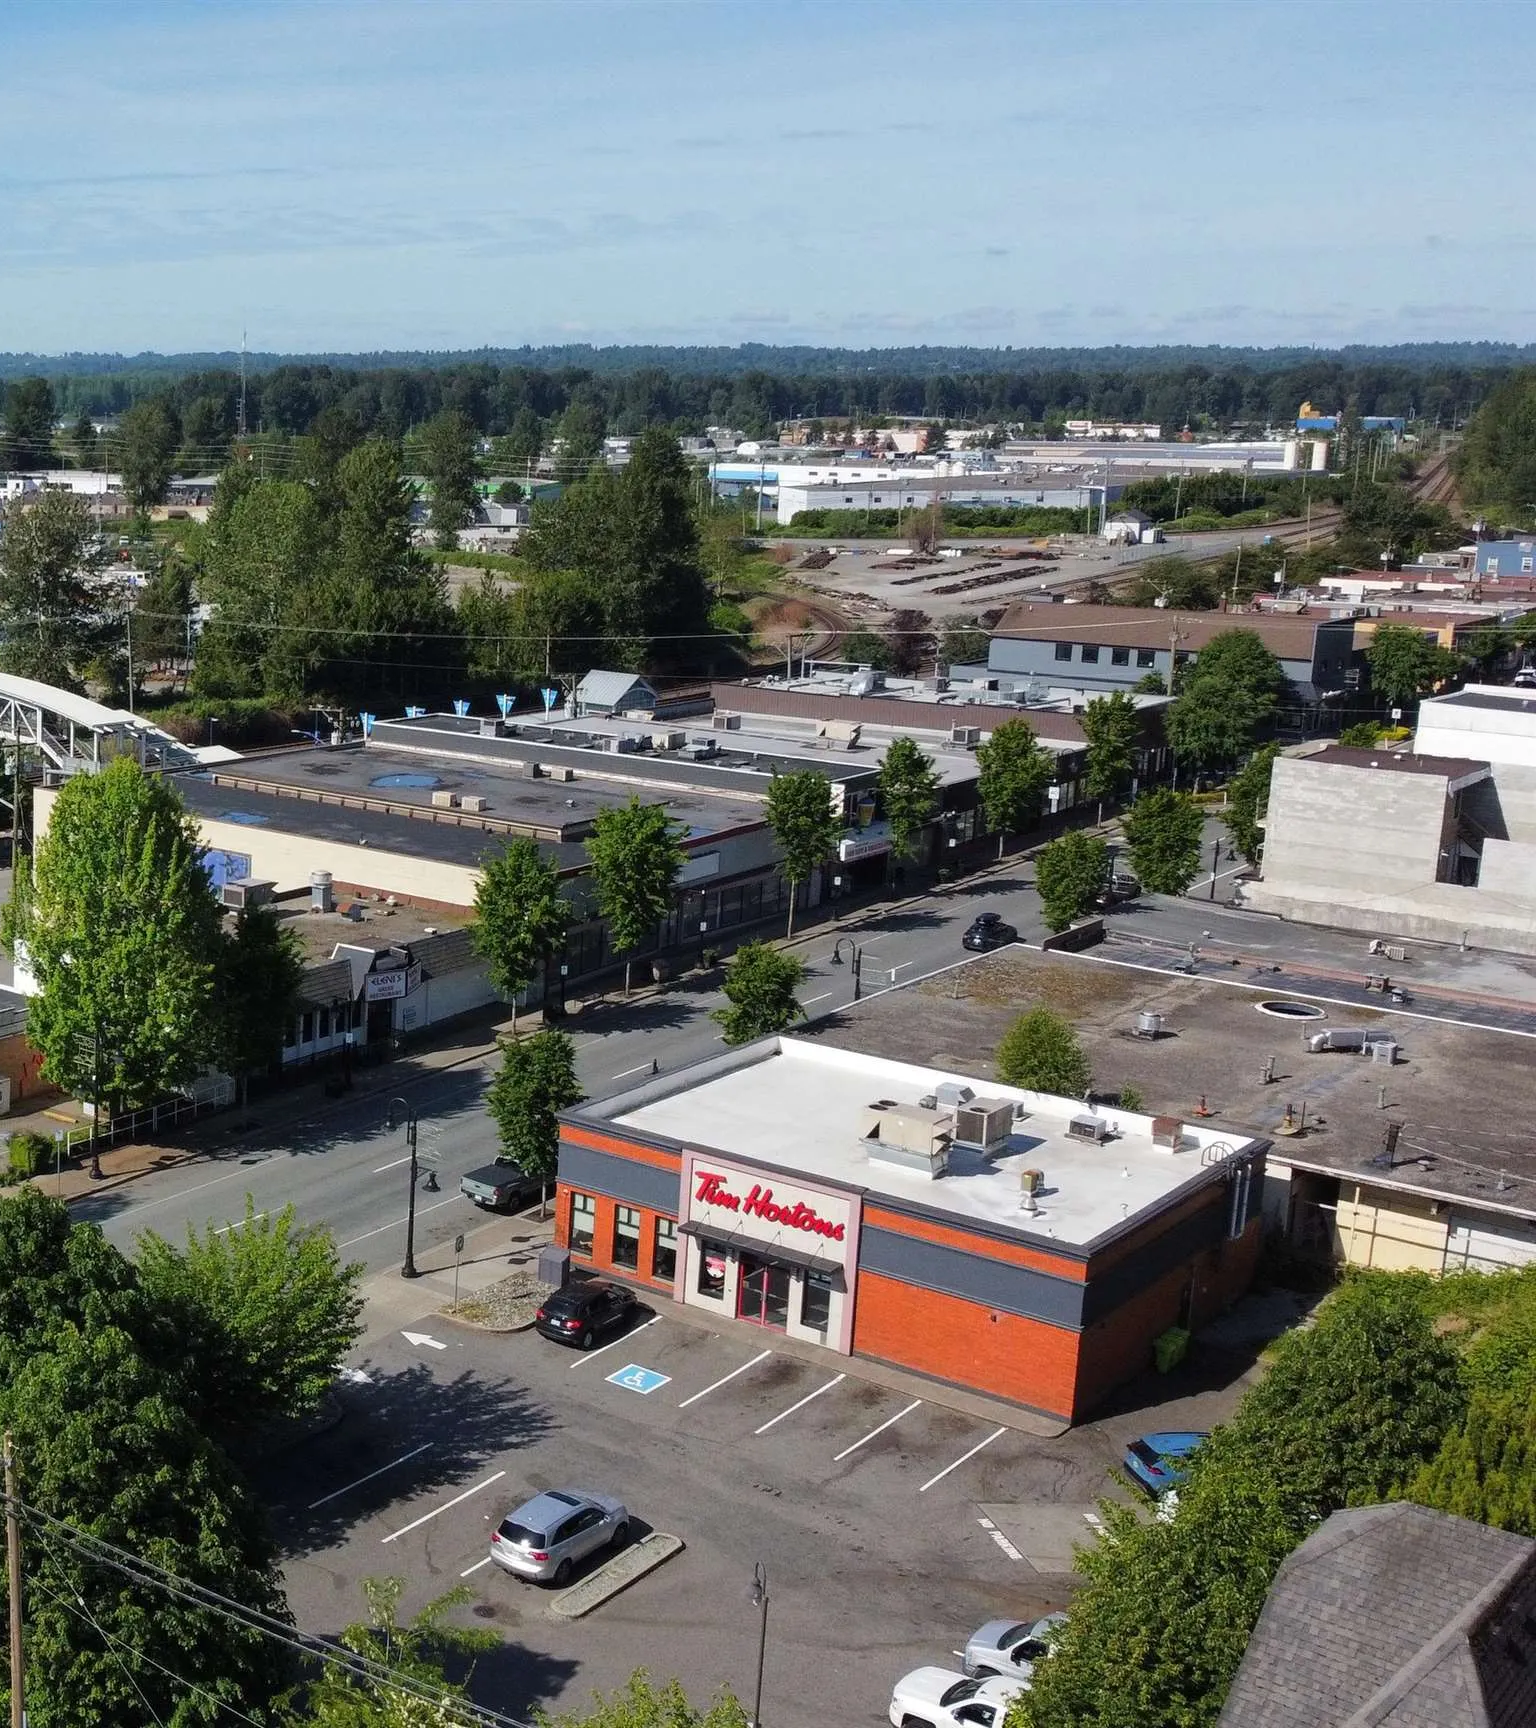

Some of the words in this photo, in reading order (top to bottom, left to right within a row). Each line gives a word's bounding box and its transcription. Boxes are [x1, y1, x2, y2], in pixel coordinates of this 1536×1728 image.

[695, 1171, 741, 1213] Tim
[742, 1184, 846, 1242] Hortons
[988, 1530, 1024, 1560] PARKING
